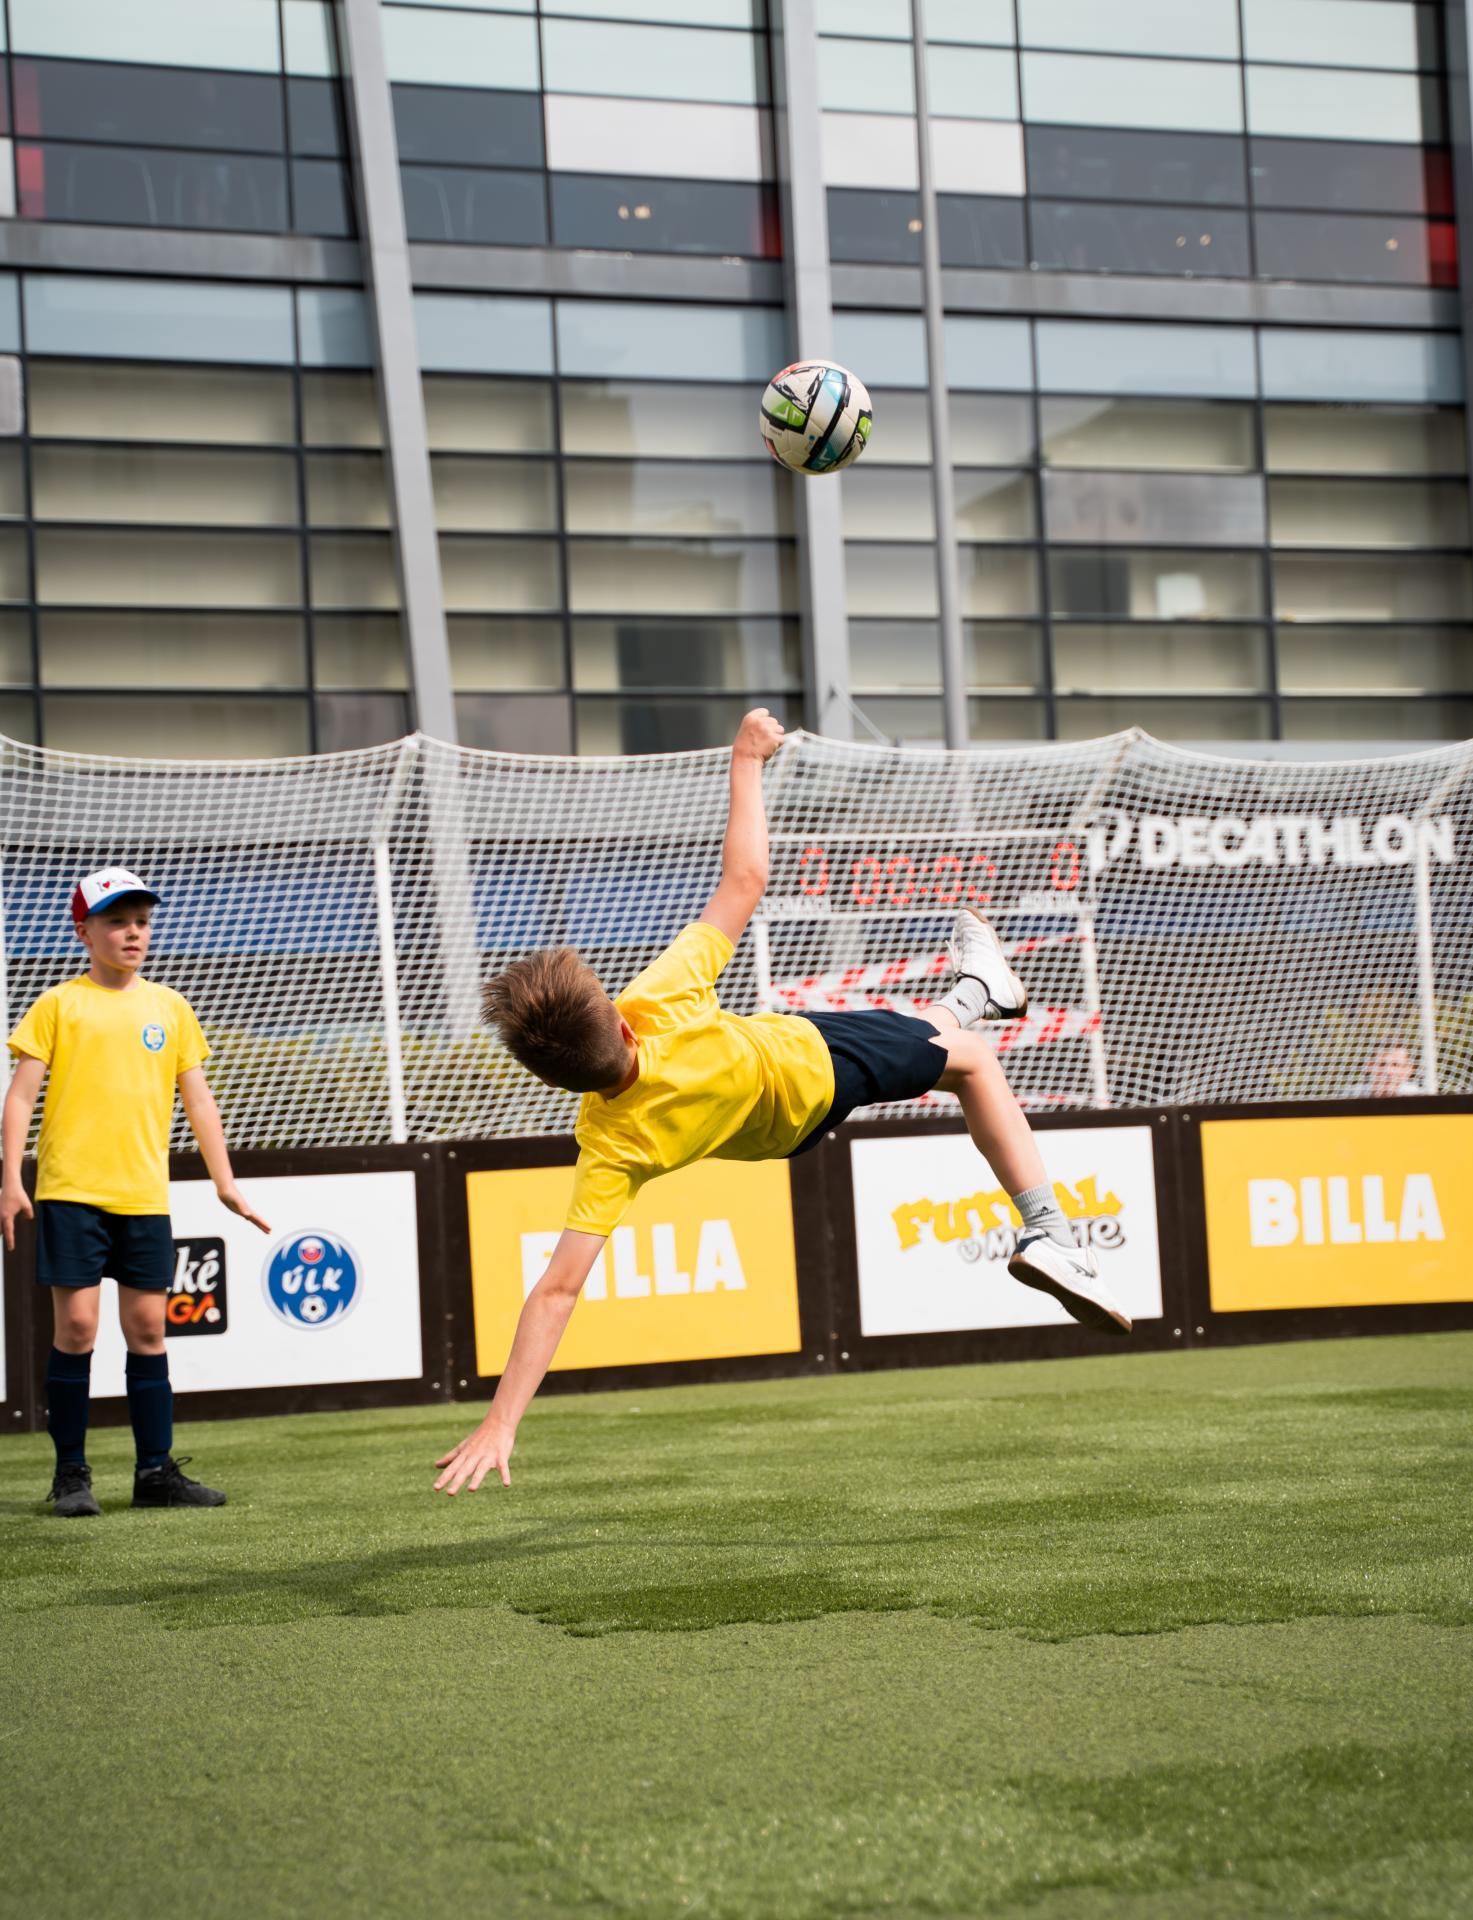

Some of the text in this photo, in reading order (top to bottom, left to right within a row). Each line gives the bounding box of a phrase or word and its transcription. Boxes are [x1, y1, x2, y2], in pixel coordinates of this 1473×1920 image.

[1050, 842, 1079, 890] 0
[1138, 813, 1456, 868] DECATHLON
[1248, 1173, 1446, 1248] BILLA
